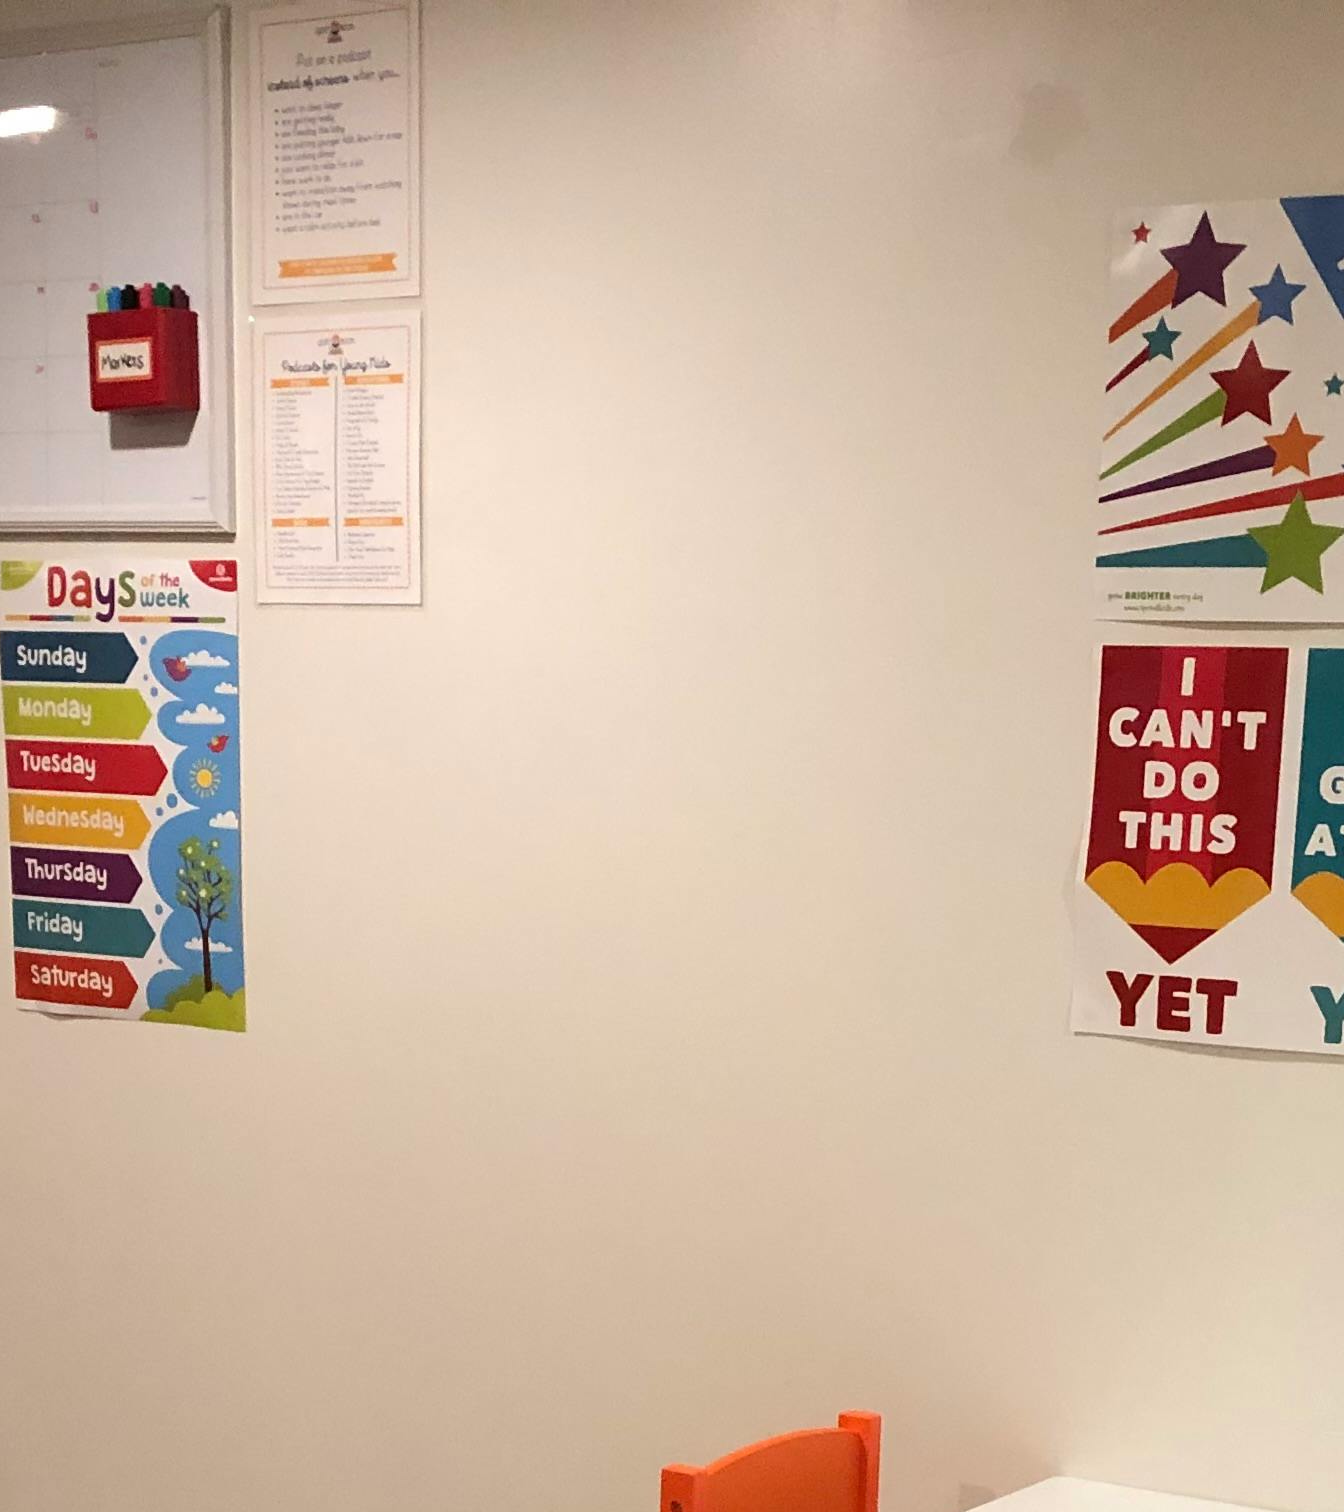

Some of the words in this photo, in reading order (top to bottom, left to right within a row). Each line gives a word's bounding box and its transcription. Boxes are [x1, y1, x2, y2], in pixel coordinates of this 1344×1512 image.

[47, 566, 135, 622] Days
[141, 572, 155, 586] of
[160, 572, 180, 586] the
[140, 588, 190, 608] week
[1124, 591, 1171, 601] BRIGHTER
[17, 645, 87, 673] Sunday
[1181, 656, 1197, 696] I
[18, 698, 92, 725] Monday
[1108, 707, 1267, 750] CAN'T
[20, 751, 96, 780] Tuesday
[1142, 760, 1220, 802] DO
[22, 806, 125, 836] Wednesday
[1119, 811, 1238, 854] THIS
[25, 858, 107, 890] Thursday
[27, 912, 83, 942] Friday
[30, 965, 113, 997] Saturday
[1106, 971, 1238, 1034] YET
